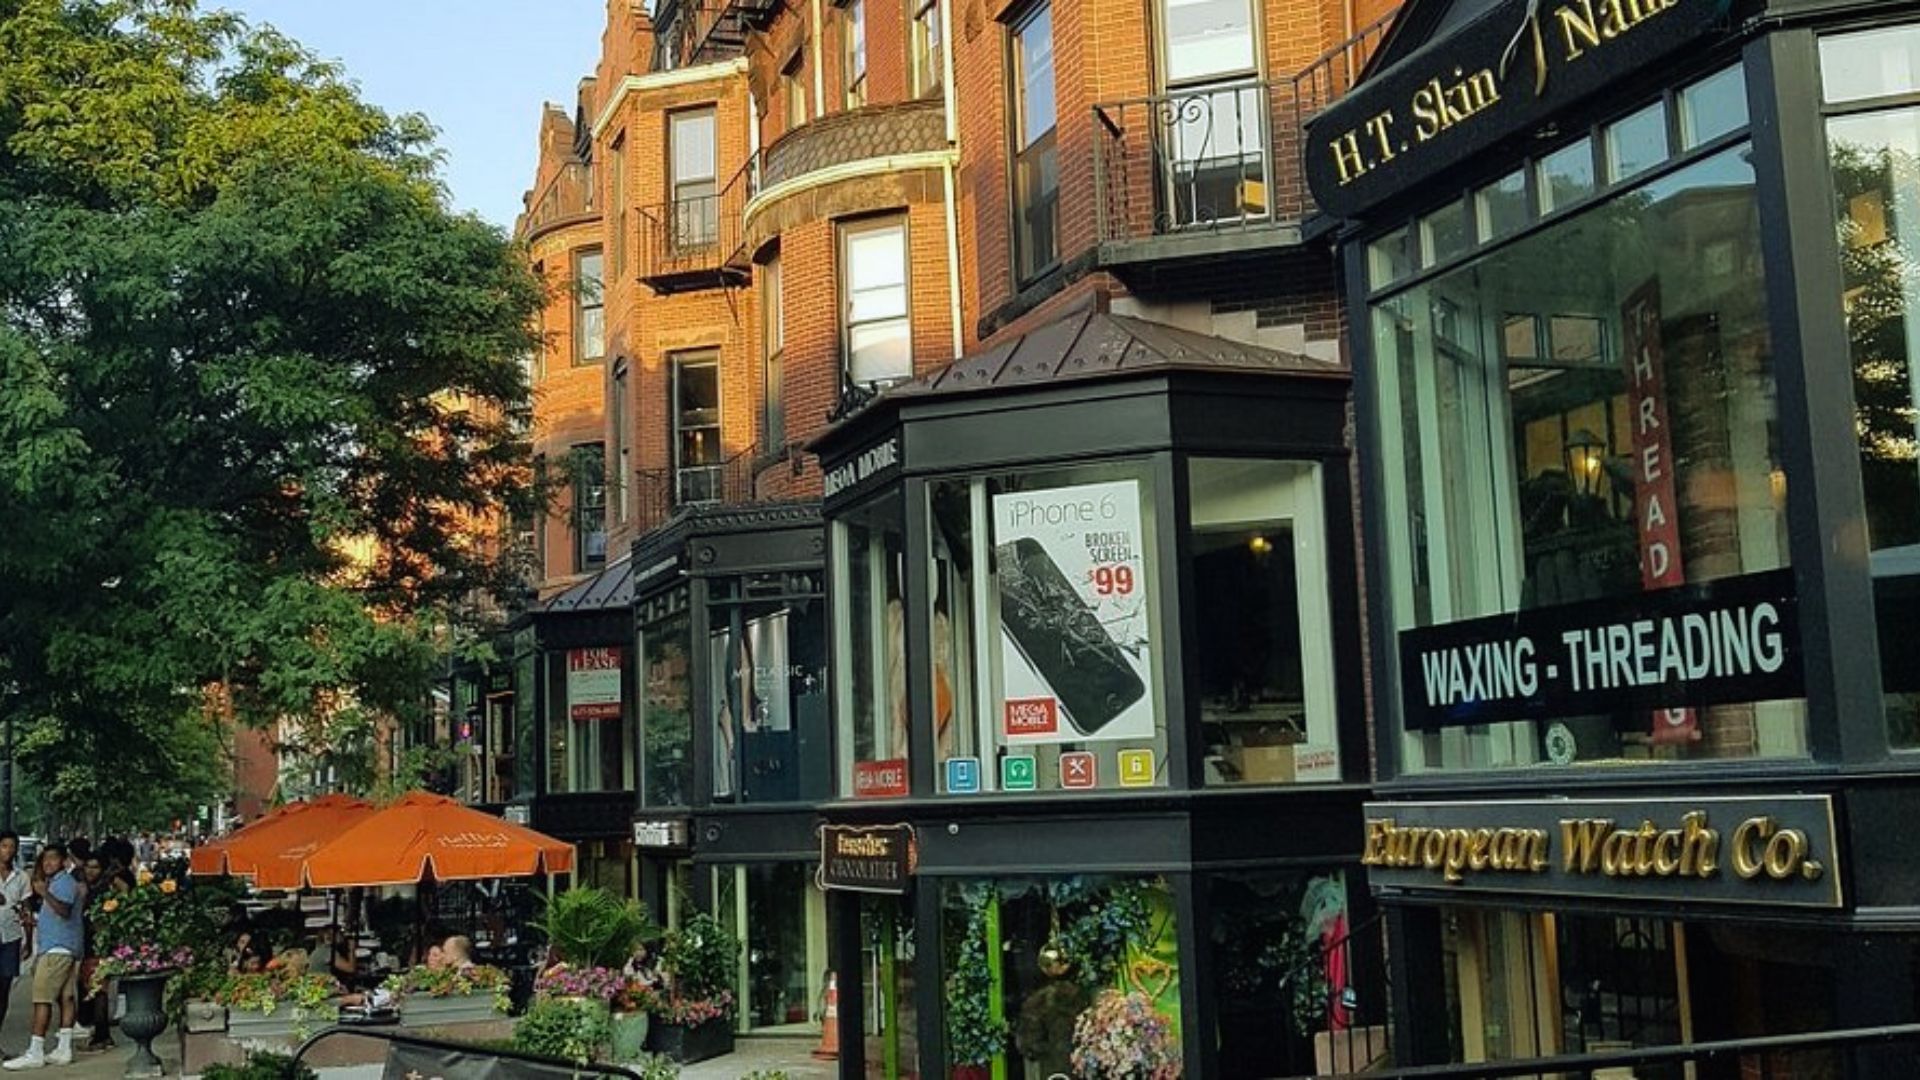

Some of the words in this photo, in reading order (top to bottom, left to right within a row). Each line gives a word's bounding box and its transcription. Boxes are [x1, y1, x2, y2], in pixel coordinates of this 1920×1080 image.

[1329, 109, 1408, 186] H.T.
[1411, 67, 1501, 142] Skin
[1009, 499, 1094, 528] iPhone
[1100, 492, 1117, 520] 6
[1085, 531, 1131, 548] BROKEN
[1087, 565, 1134, 595] $99
[1421, 636, 1539, 706] WAXING
[1562, 602, 1784, 692] THREADING
[1361, 818, 1551, 882] European
[1559, 810, 1719, 878] Watch
[1730, 816, 1824, 879] Co.
